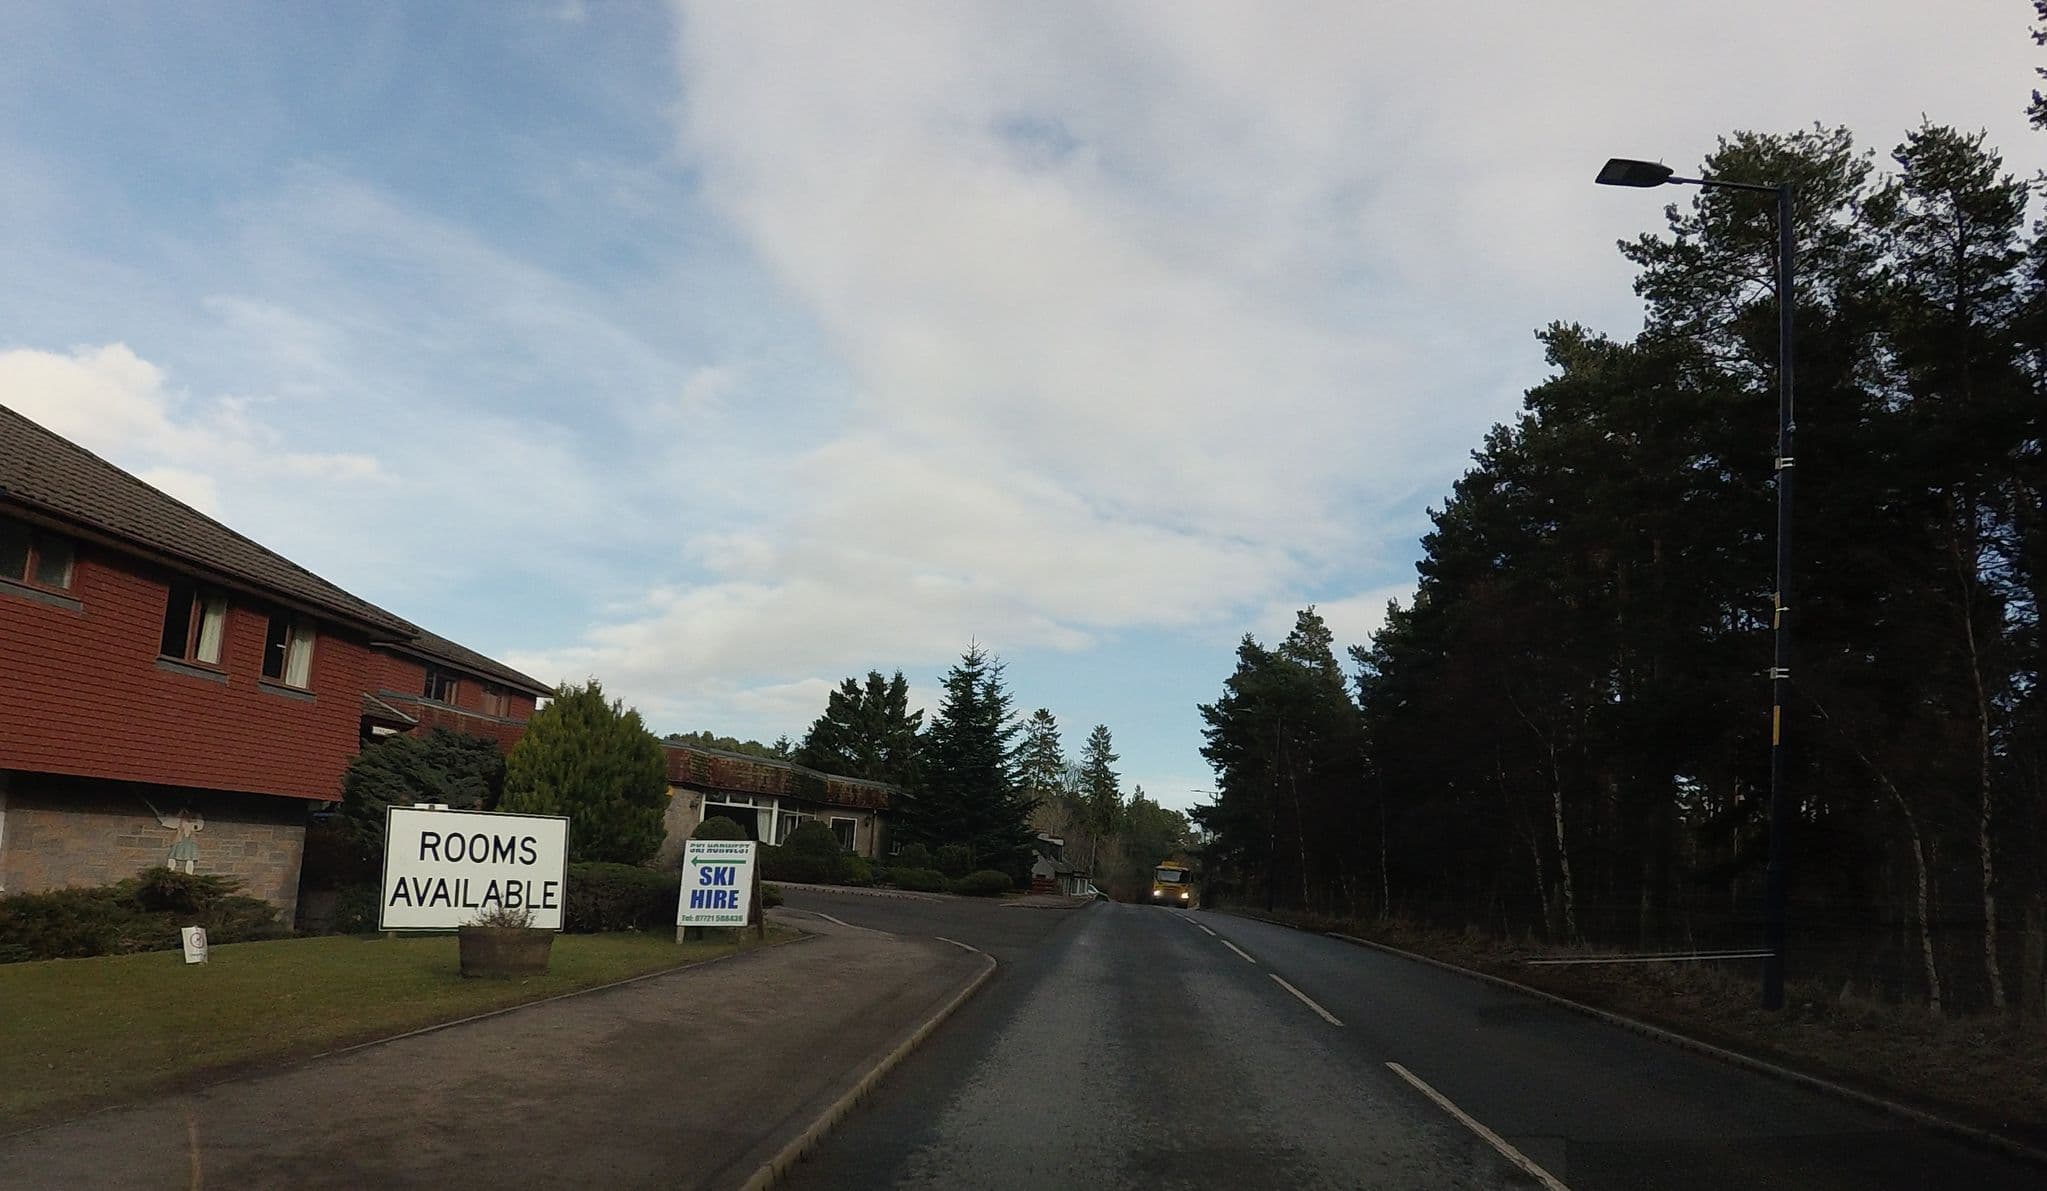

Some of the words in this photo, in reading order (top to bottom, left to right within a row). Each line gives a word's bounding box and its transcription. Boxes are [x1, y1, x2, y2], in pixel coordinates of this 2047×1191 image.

[419, 831, 537, 865] ROOMS
[699, 866, 736, 886] SKI
[389, 877, 558, 909] AVAILABLE
[690, 889, 739, 909] HIRE
